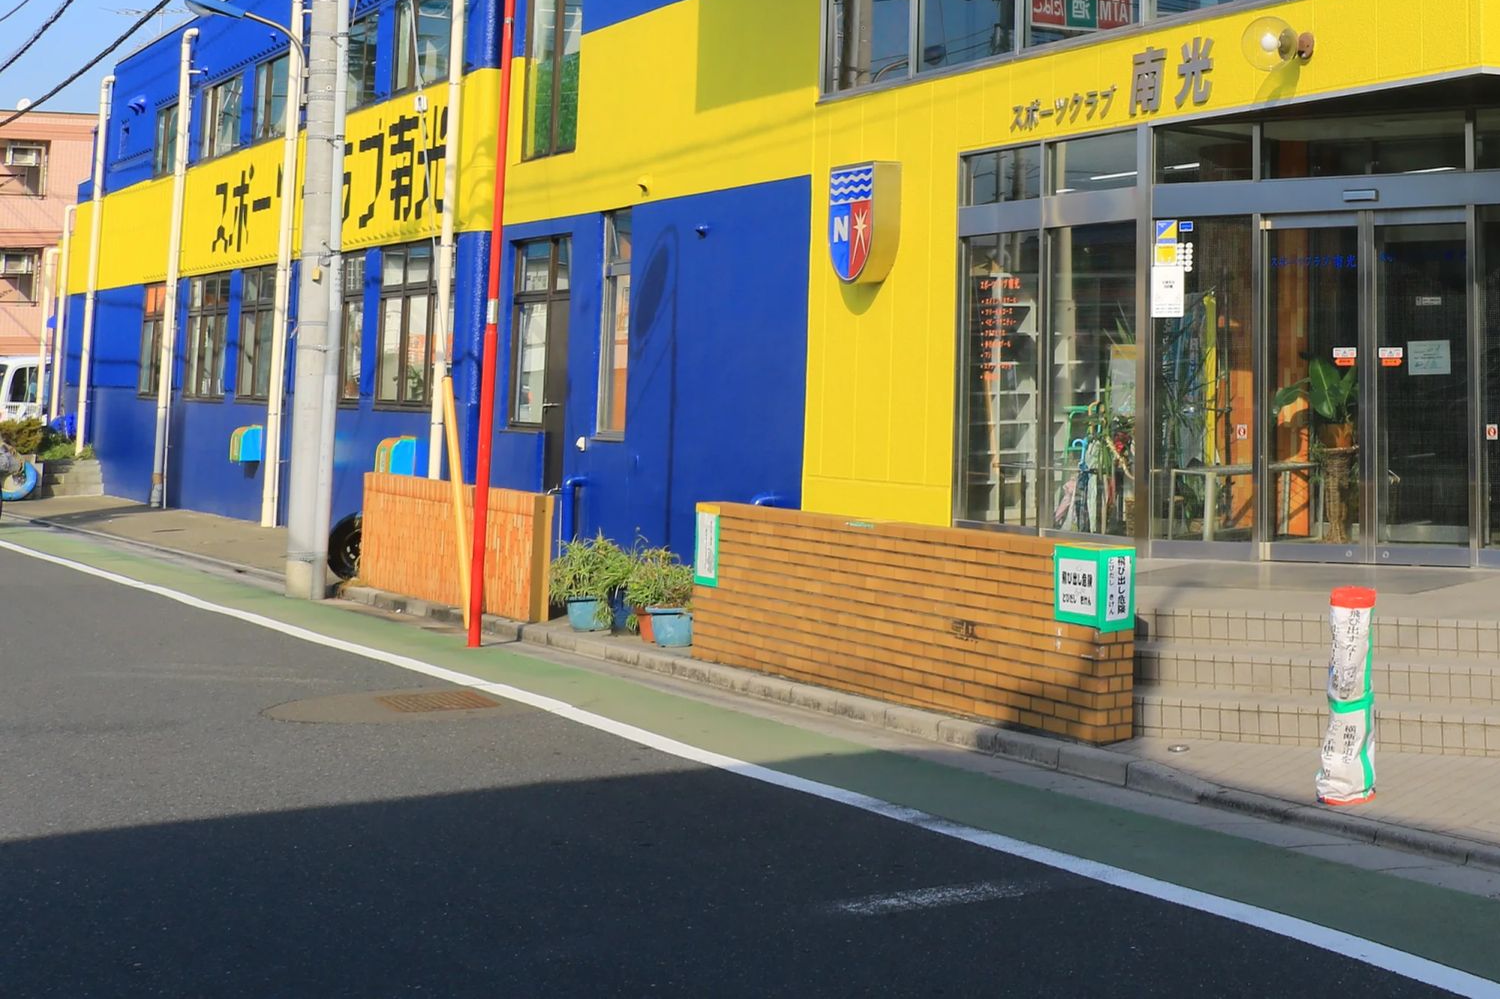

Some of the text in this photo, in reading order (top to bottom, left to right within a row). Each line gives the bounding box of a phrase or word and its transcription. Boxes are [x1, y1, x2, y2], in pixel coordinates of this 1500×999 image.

[1010, 37, 1216, 133] スポーツクラブ 南光
[833, 215, 849, 243] N
